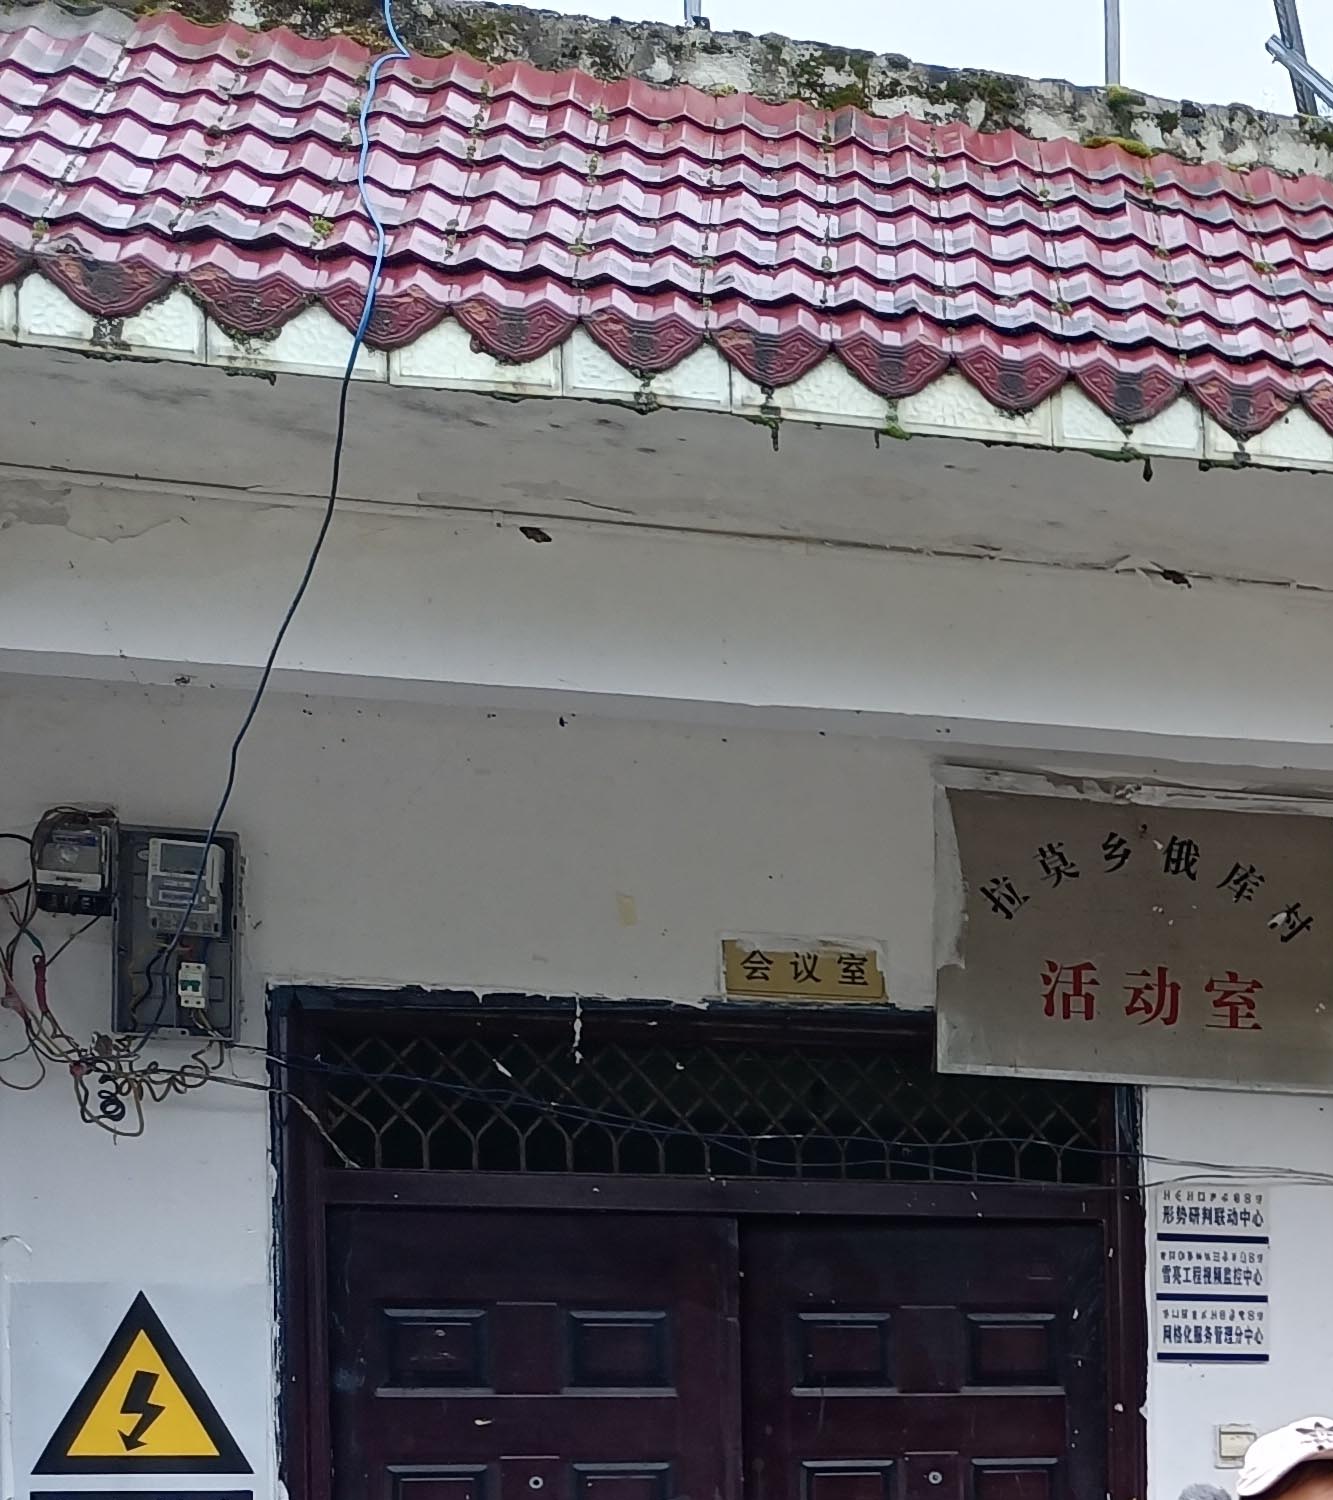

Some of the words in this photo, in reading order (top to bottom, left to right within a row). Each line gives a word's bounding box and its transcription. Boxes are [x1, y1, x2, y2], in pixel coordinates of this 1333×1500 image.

[979, 831, 1314, 943] 拉莫乡俄库村
[740, 950, 870, 986] 会议室
[1040, 959, 1264, 1031] 活动室
[1162, 1205, 1264, 1228] 形势研判联动中心
[1161, 1264, 1263, 1286] 雪亮工程视频监控中心
